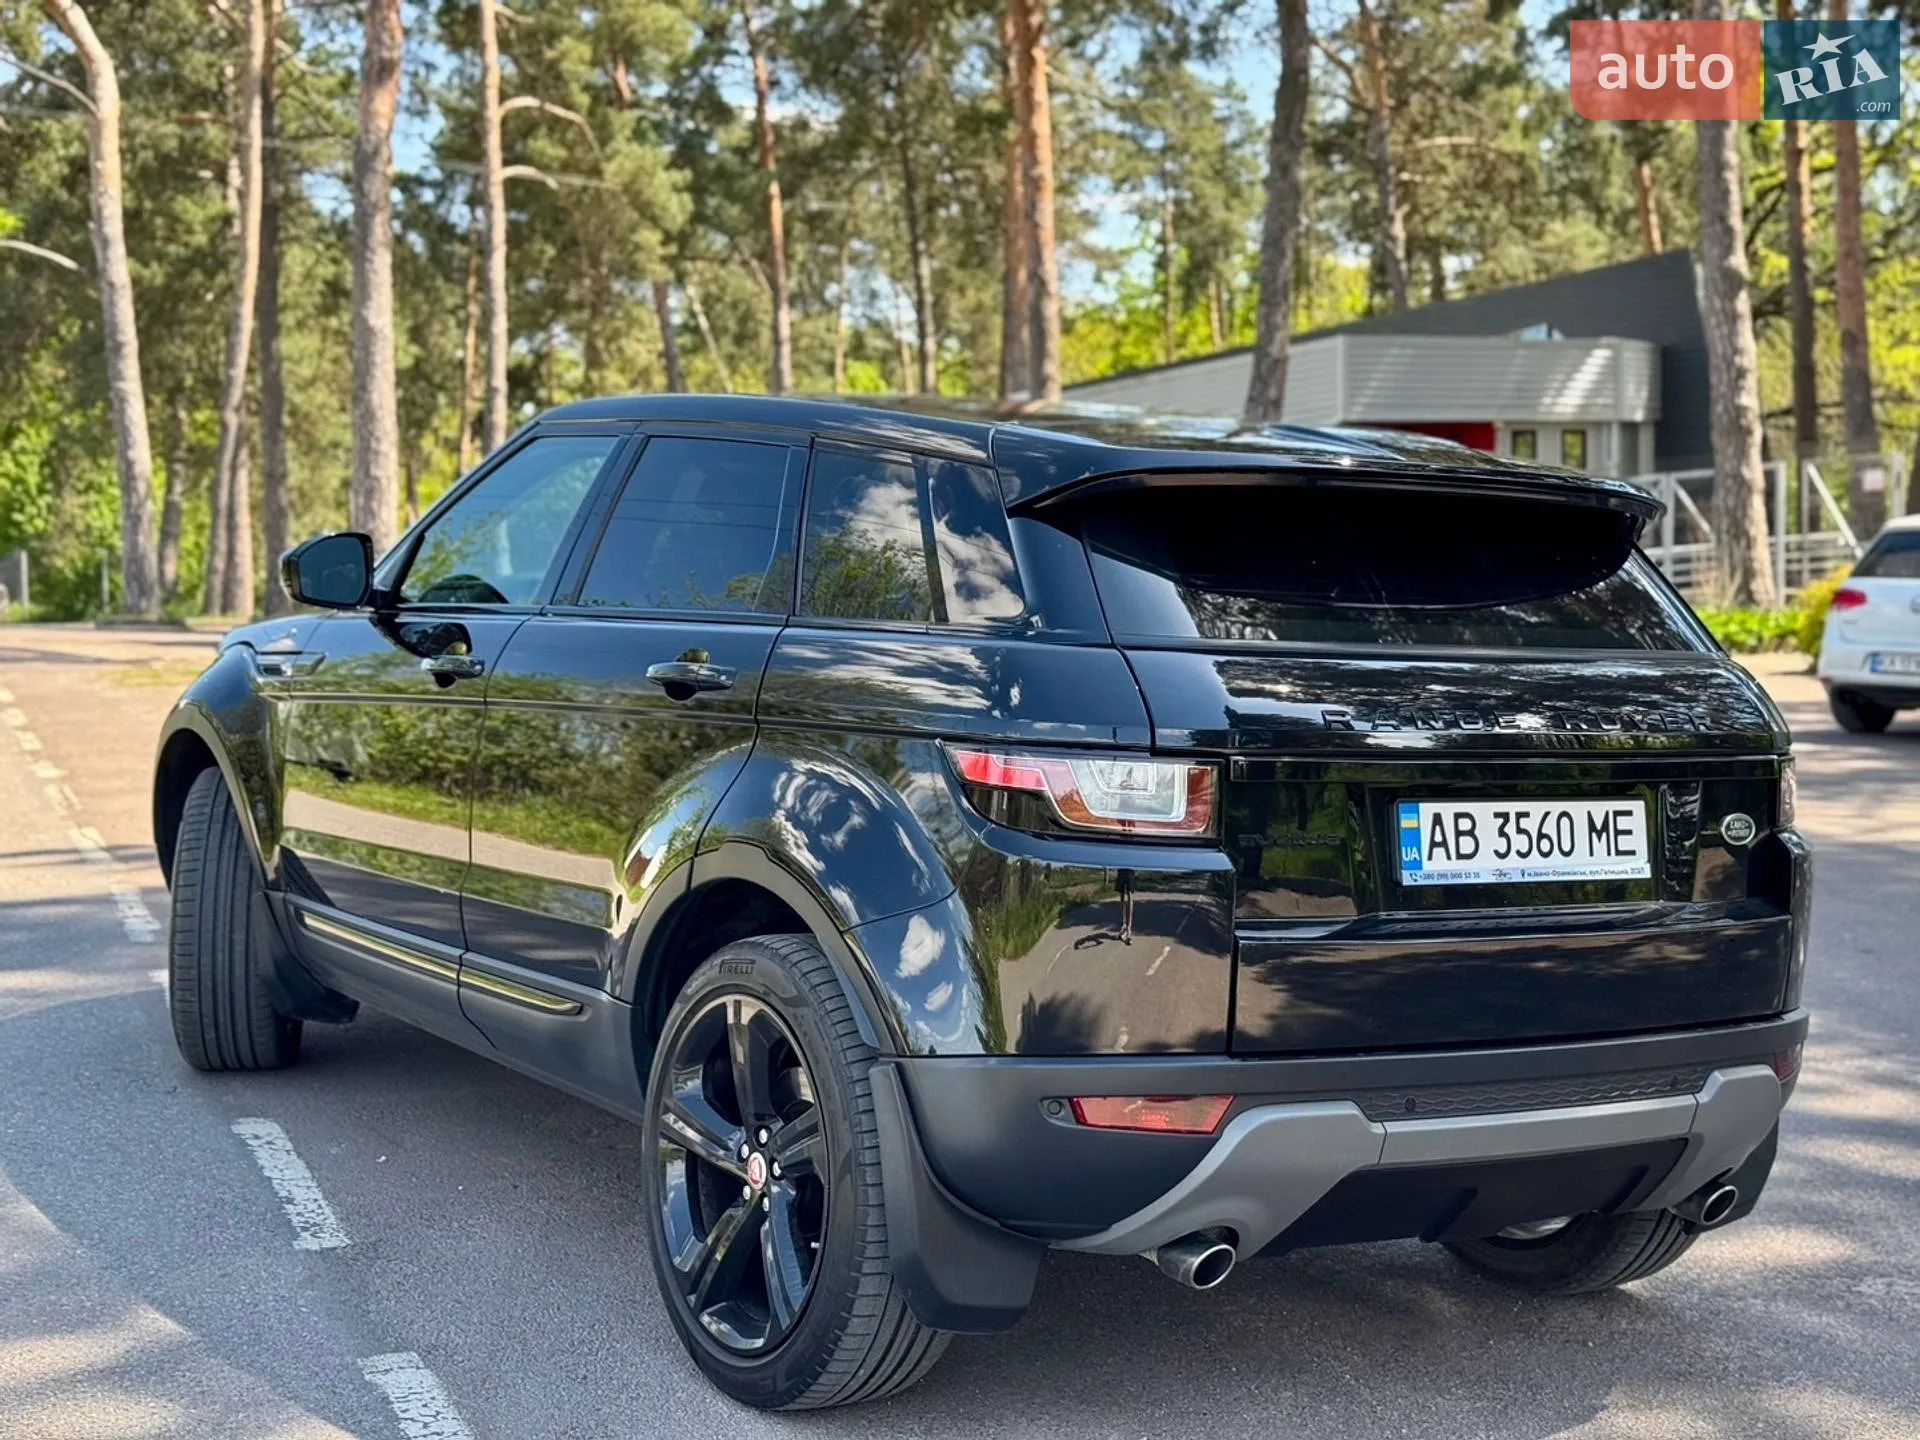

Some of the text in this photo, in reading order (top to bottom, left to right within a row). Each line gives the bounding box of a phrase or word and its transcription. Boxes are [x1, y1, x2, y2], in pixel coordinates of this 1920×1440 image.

[1320, 709, 1713, 731] RANGE ROVER
[1426, 809, 1637, 861] AB 3560 ME
[1402, 846, 1420, 862] UA
[718, 958, 757, 975] PIRELLI
